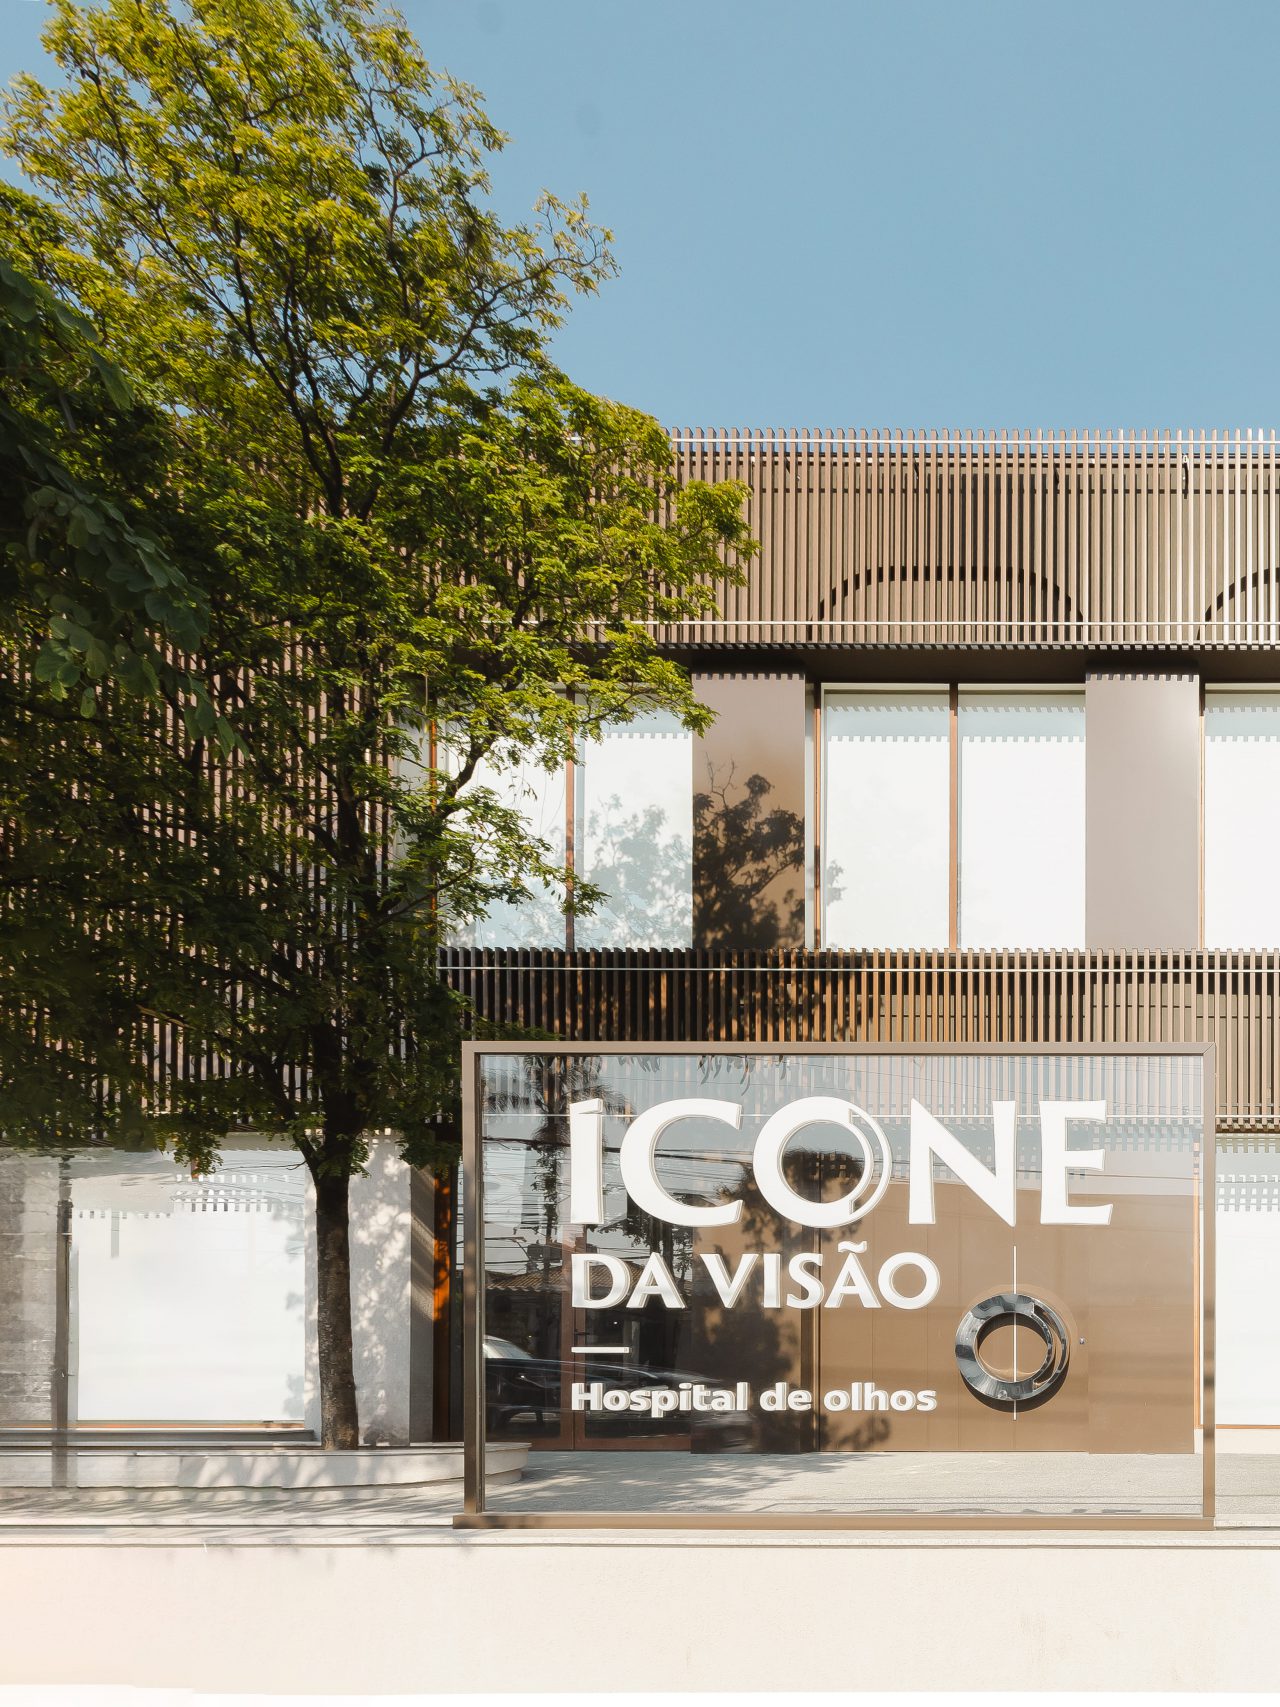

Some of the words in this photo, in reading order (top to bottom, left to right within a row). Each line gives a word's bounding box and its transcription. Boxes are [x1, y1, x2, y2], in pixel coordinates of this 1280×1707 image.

[571, 1252, 687, 1309] DA
[700, 1240, 941, 1309] VISÃO
[571, 1381, 750, 1418] Hospital
[759, 1382, 812, 1412] de
[823, 1382, 938, 1412] olhos
